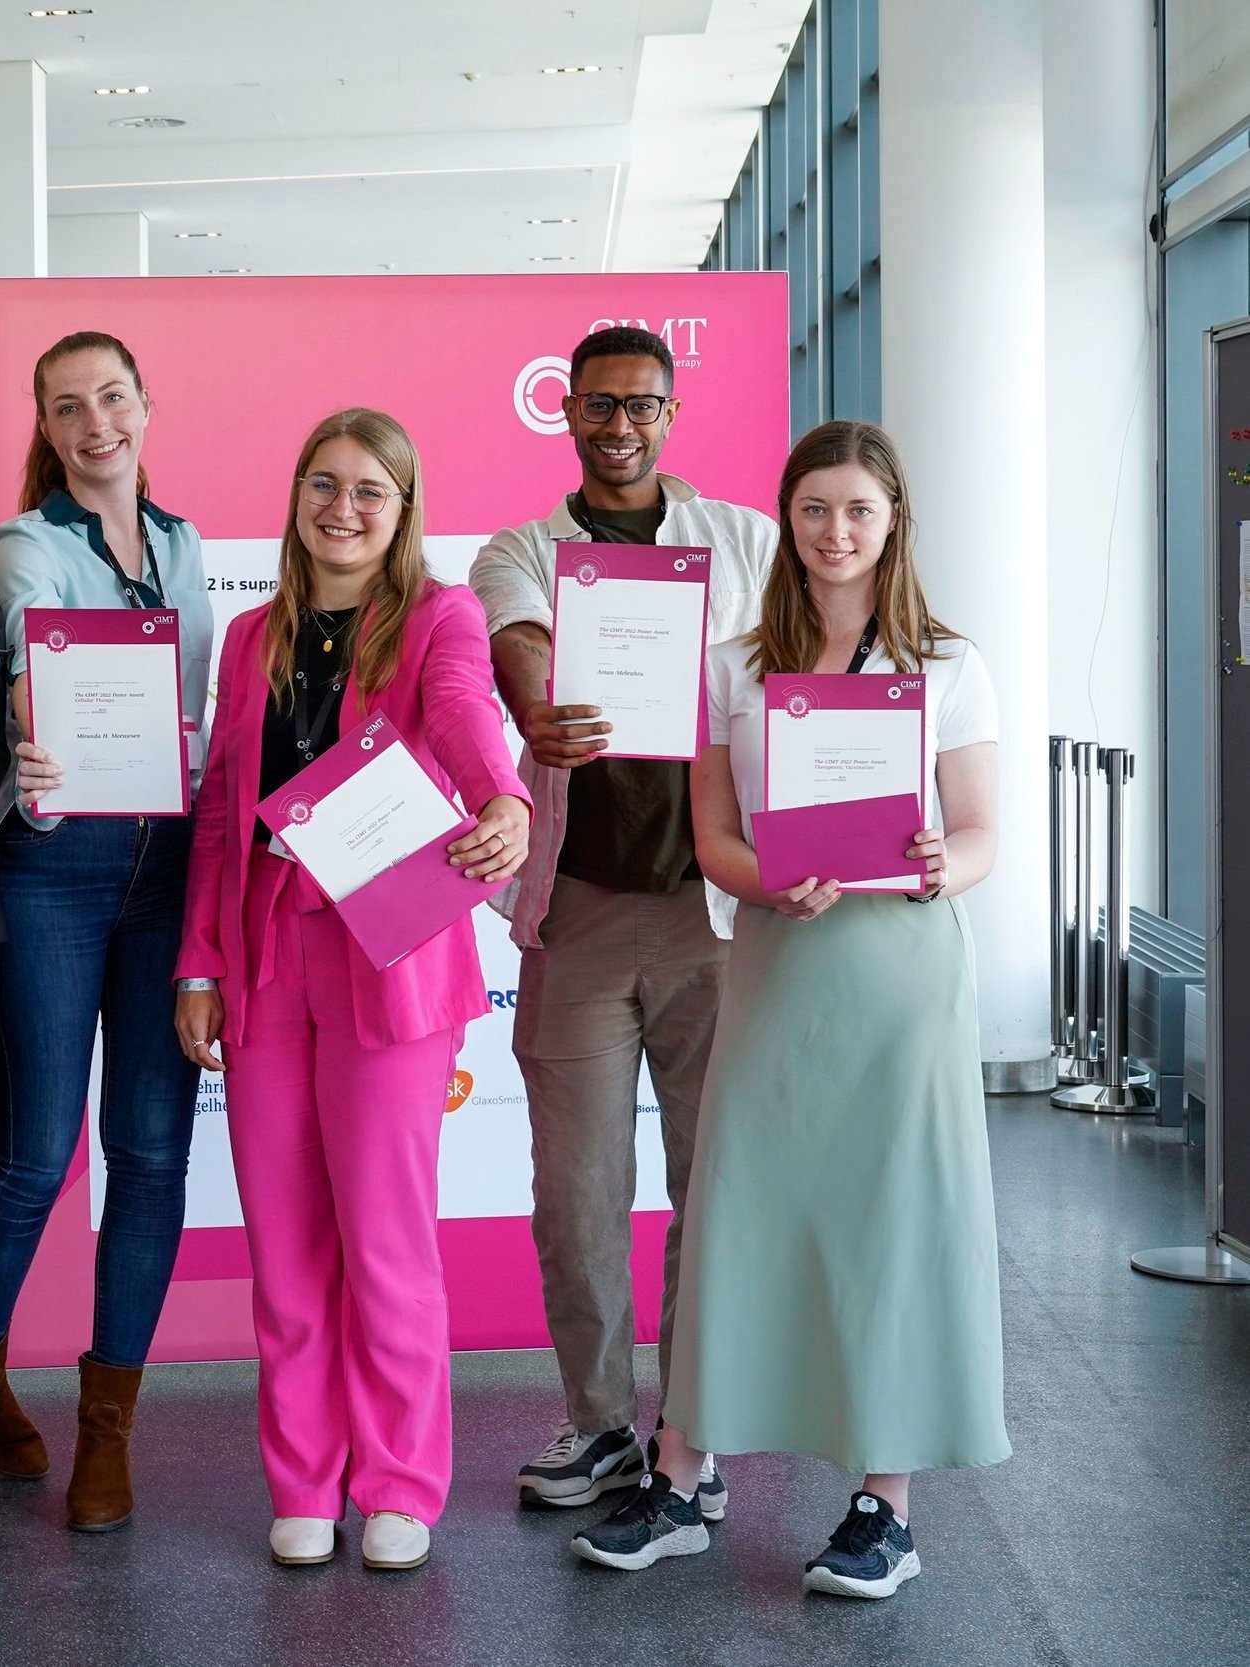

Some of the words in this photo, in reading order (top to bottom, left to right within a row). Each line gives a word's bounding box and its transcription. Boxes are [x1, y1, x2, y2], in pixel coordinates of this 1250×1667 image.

[686, 553, 708, 562] CIMT
[221, 578, 235, 591] is
[239, 580, 279, 593] supp
[366, 718, 385, 736] CIMT
[355, 829, 367, 841] CIMT
[471, 1094, 528, 1106] GlaxoSmith
